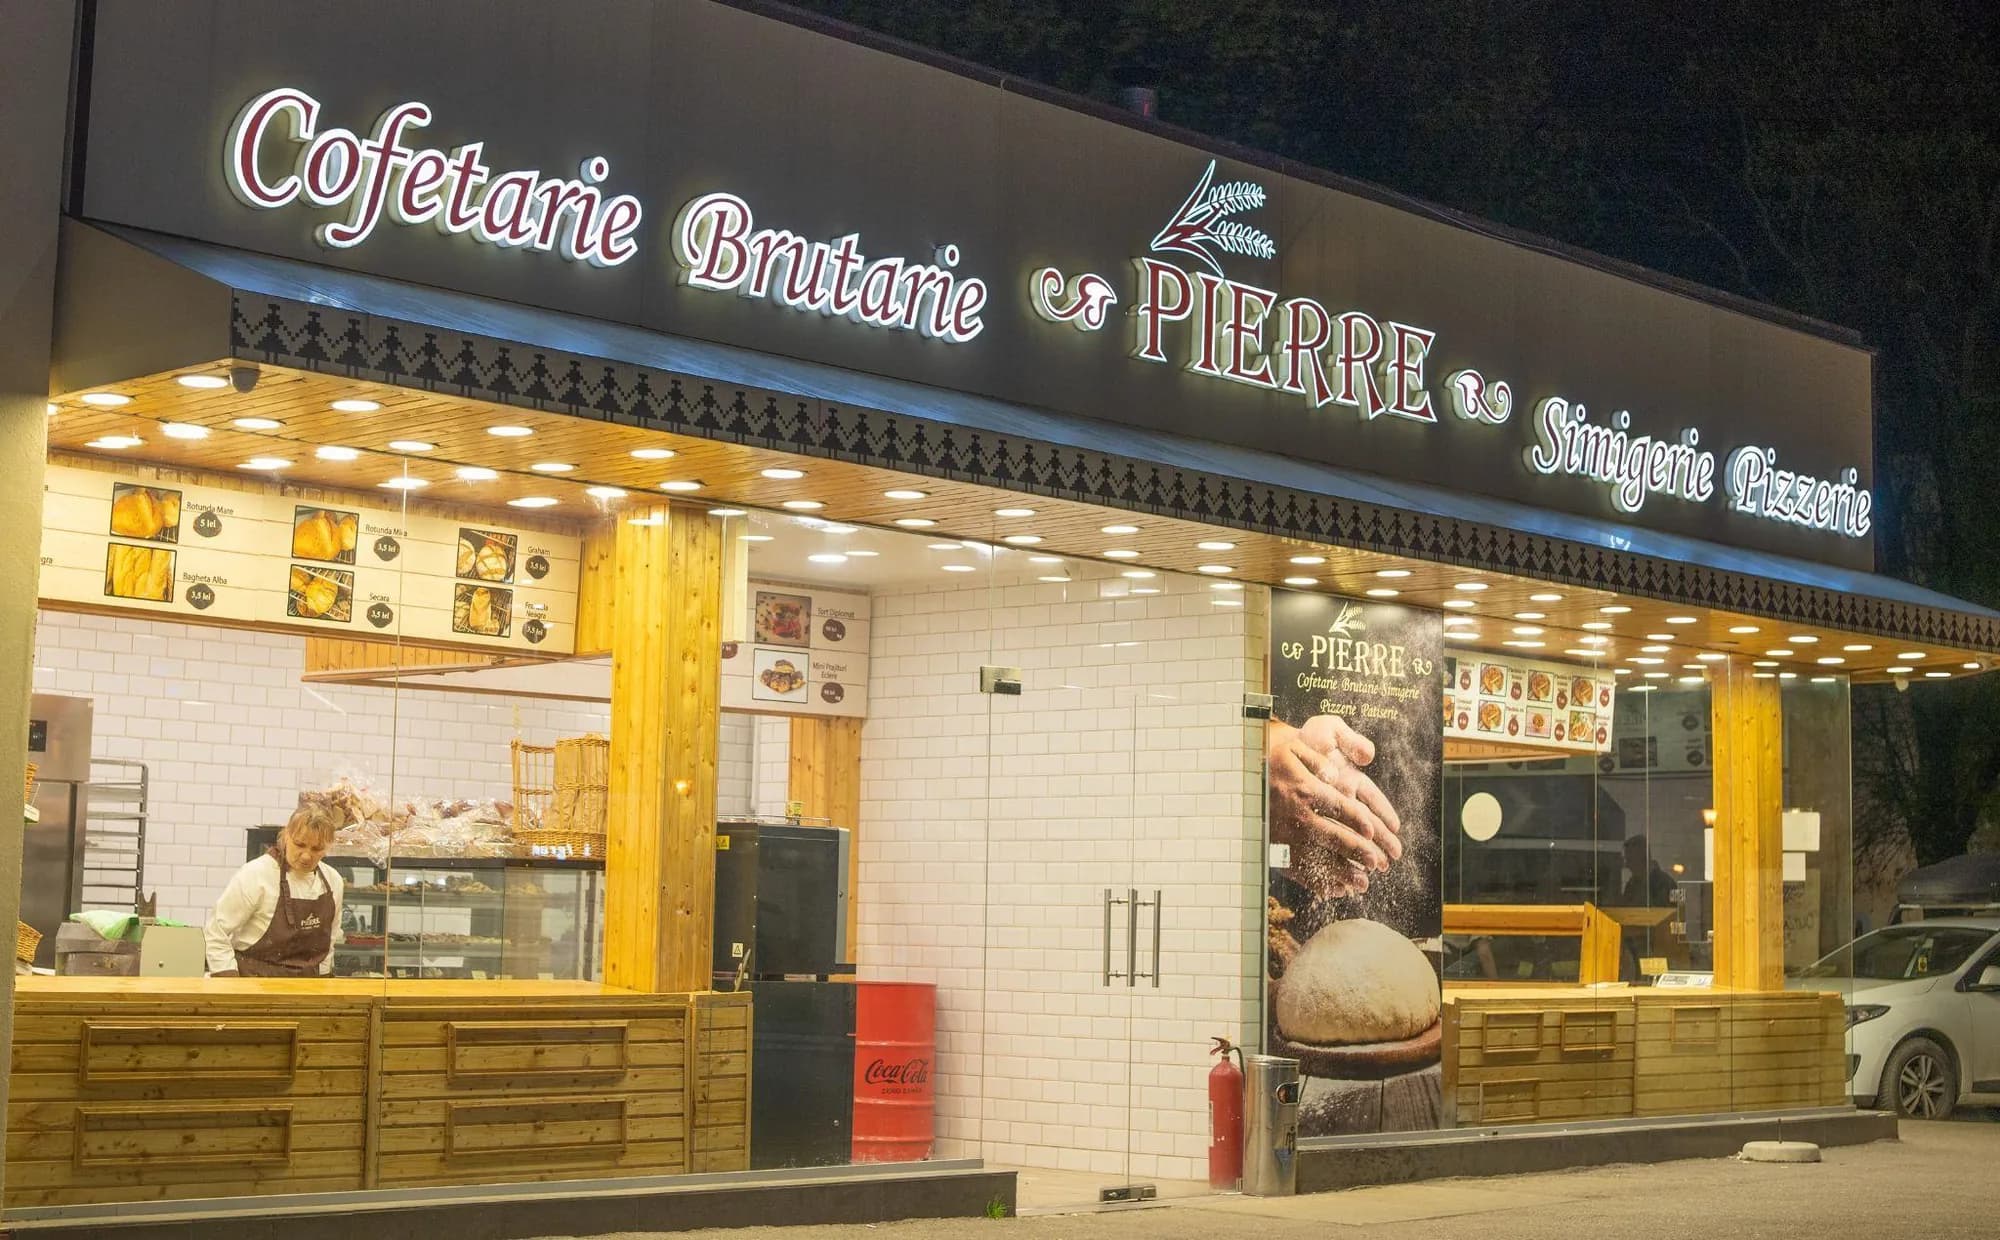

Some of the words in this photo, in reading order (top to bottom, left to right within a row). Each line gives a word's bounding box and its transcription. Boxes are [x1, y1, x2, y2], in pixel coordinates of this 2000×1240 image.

[228, 86, 643, 268] Cofetarie
[674, 191, 988, 343] Brutarie
[1133, 256, 1438, 424] PIERRE
[1529, 396, 1715, 512] Simigerie
[1730, 445, 1873, 537] Pizzerie
[186, 501, 216, 512] Rotunda
[200, 519, 206, 528] 5
[207, 519, 216, 528] lei
[365, 523, 392, 535] Rotunda
[527, 546, 551, 556] Graham
[183, 572, 211, 583] Bagheta
[212, 575, 228, 584] Alba
[191, 591, 202, 601] 3,5
[369, 592, 390, 602] Secara
[1310, 634, 1406, 680] PIERRE
[1297, 672, 1338, 692] Cofetarie
[1341, 677, 1379, 695] Brutarie
[1320, 698, 1357, 716] Pizzerie
